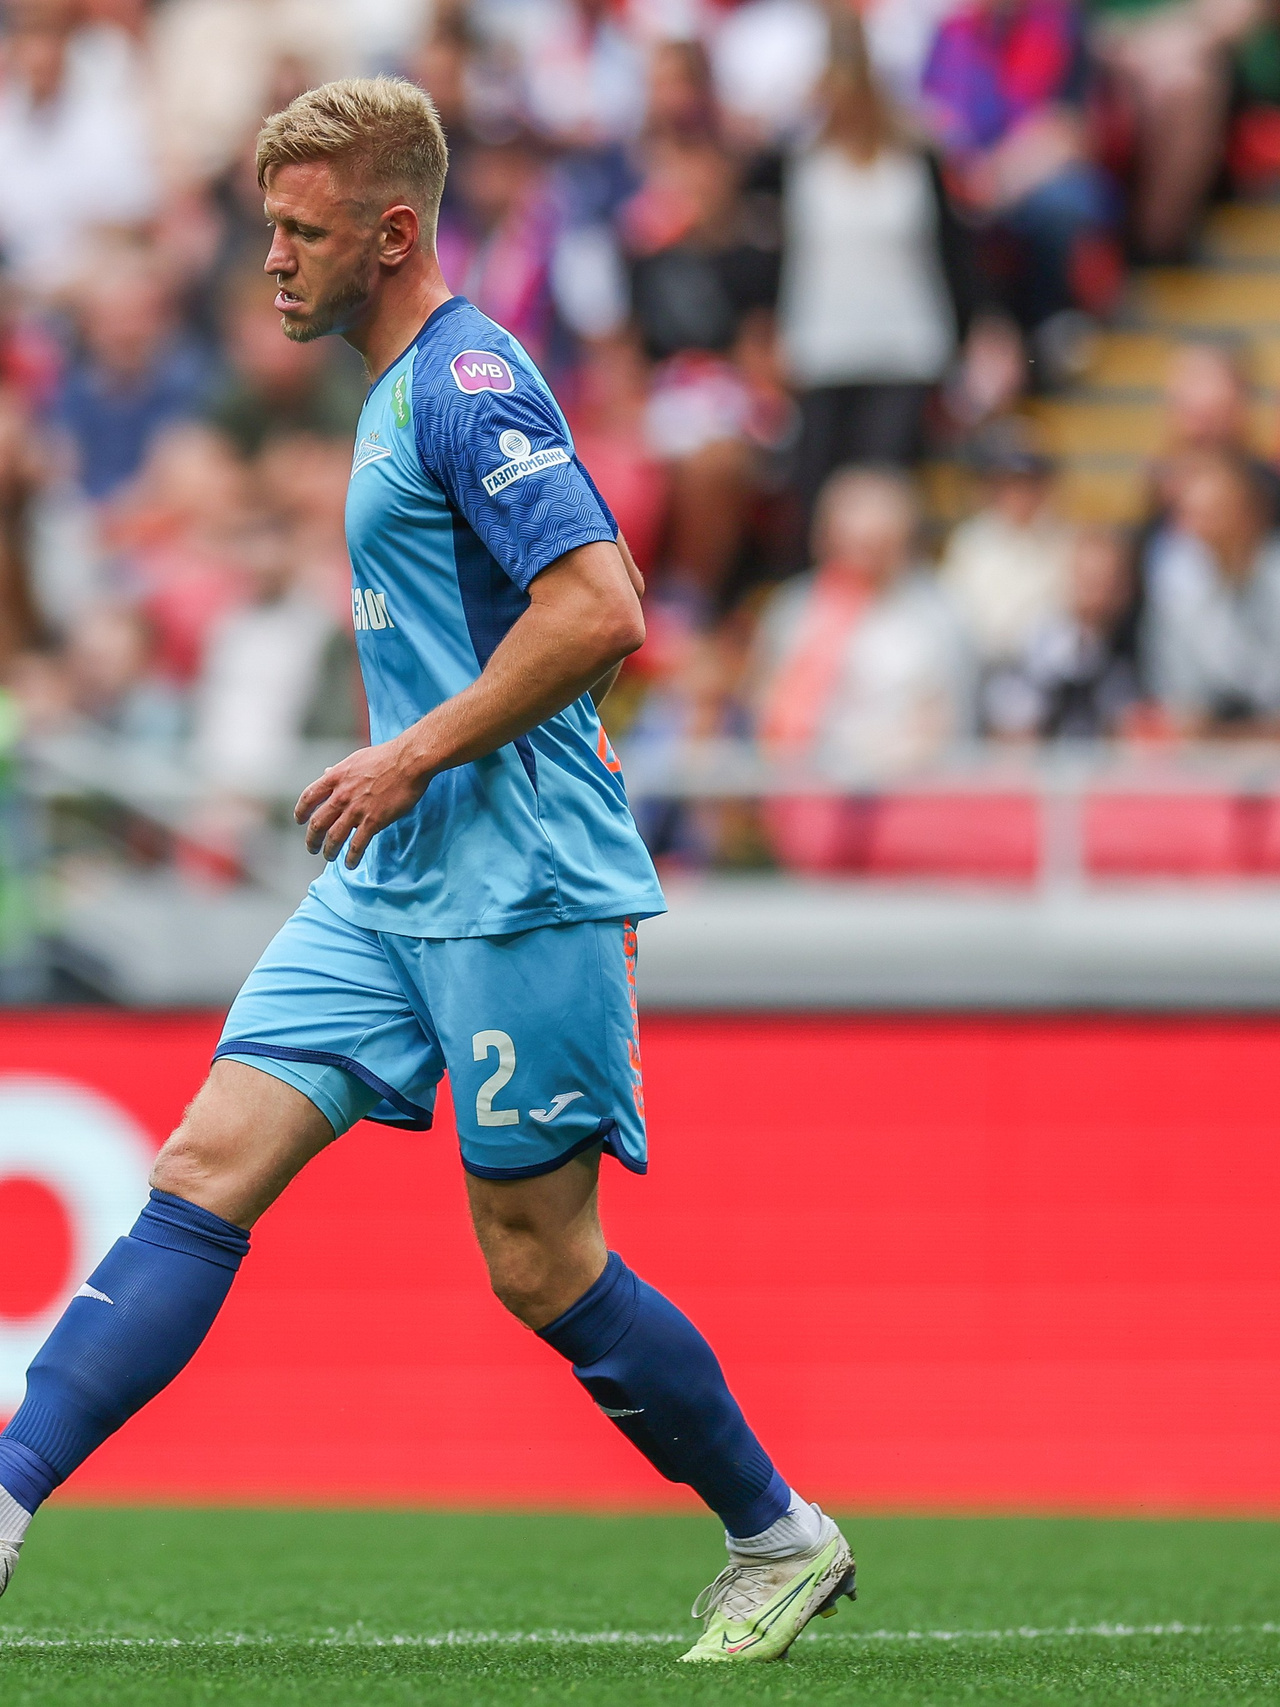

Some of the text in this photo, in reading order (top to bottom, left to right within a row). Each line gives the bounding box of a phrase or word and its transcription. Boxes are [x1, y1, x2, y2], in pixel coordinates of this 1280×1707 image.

[462, 362, 504, 378] WB
[486, 450, 565, 491] ГАЗПРОМБАНК
[472, 1030, 519, 1127] 2
